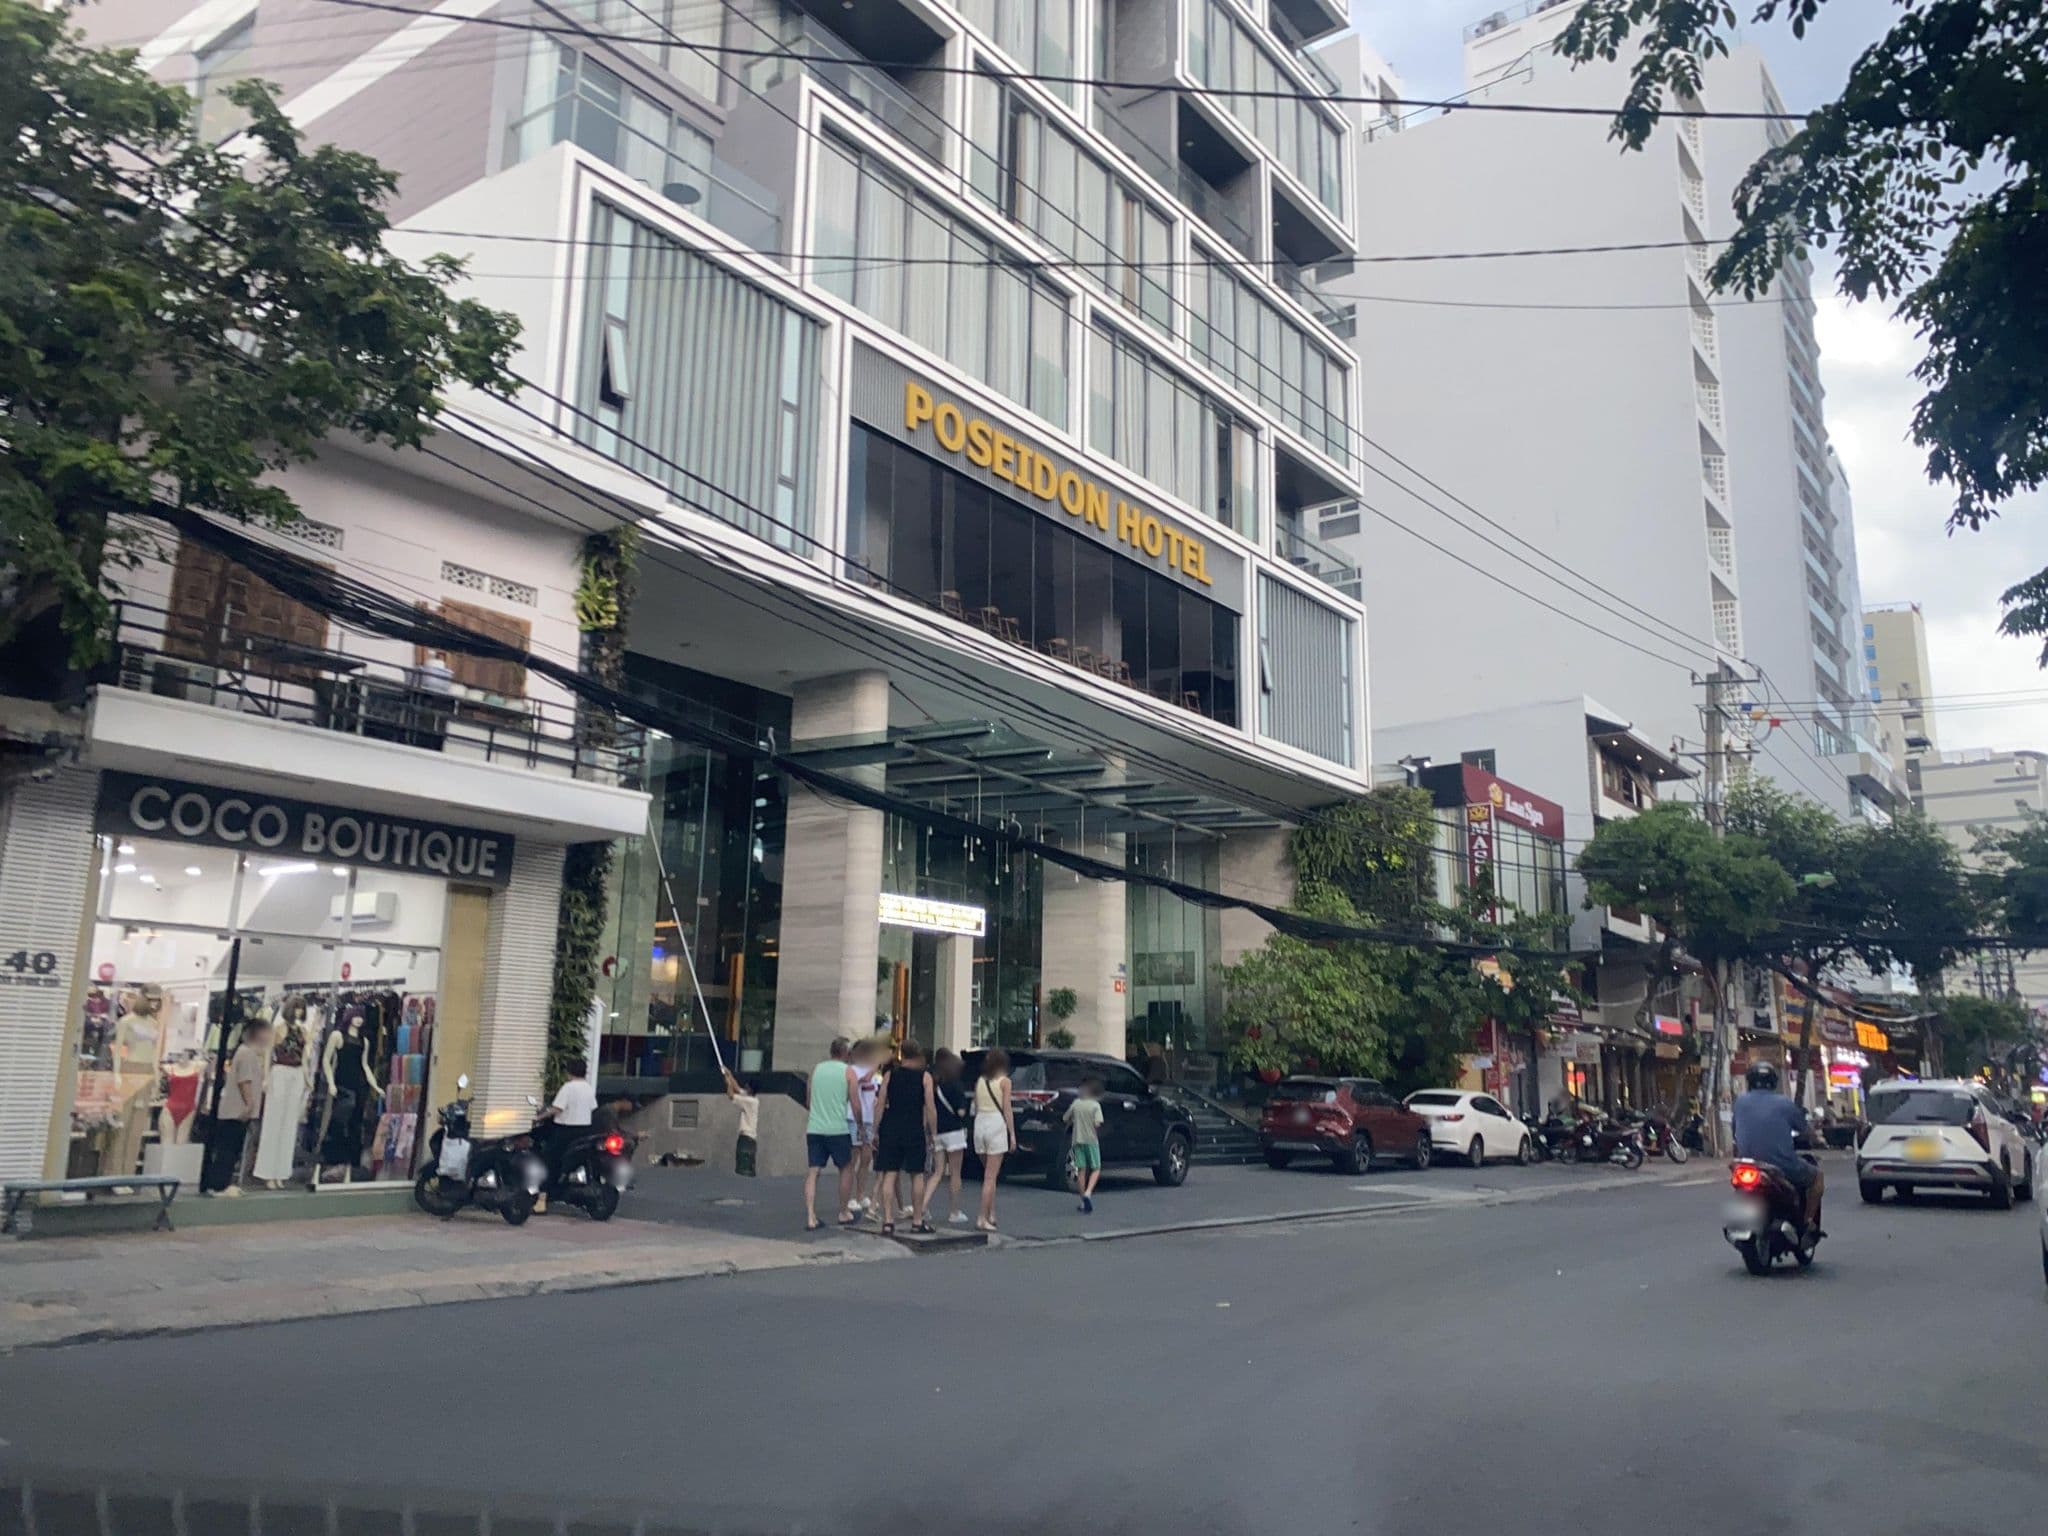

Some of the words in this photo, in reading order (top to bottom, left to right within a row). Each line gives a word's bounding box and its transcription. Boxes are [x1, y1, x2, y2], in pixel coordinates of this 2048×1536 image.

[906, 382, 1109, 530] POSEIDON
[1117, 501, 1213, 586] HOTEL
[130, 786, 288, 847] COCO
[302, 812, 499, 878] BOUTIQUE
